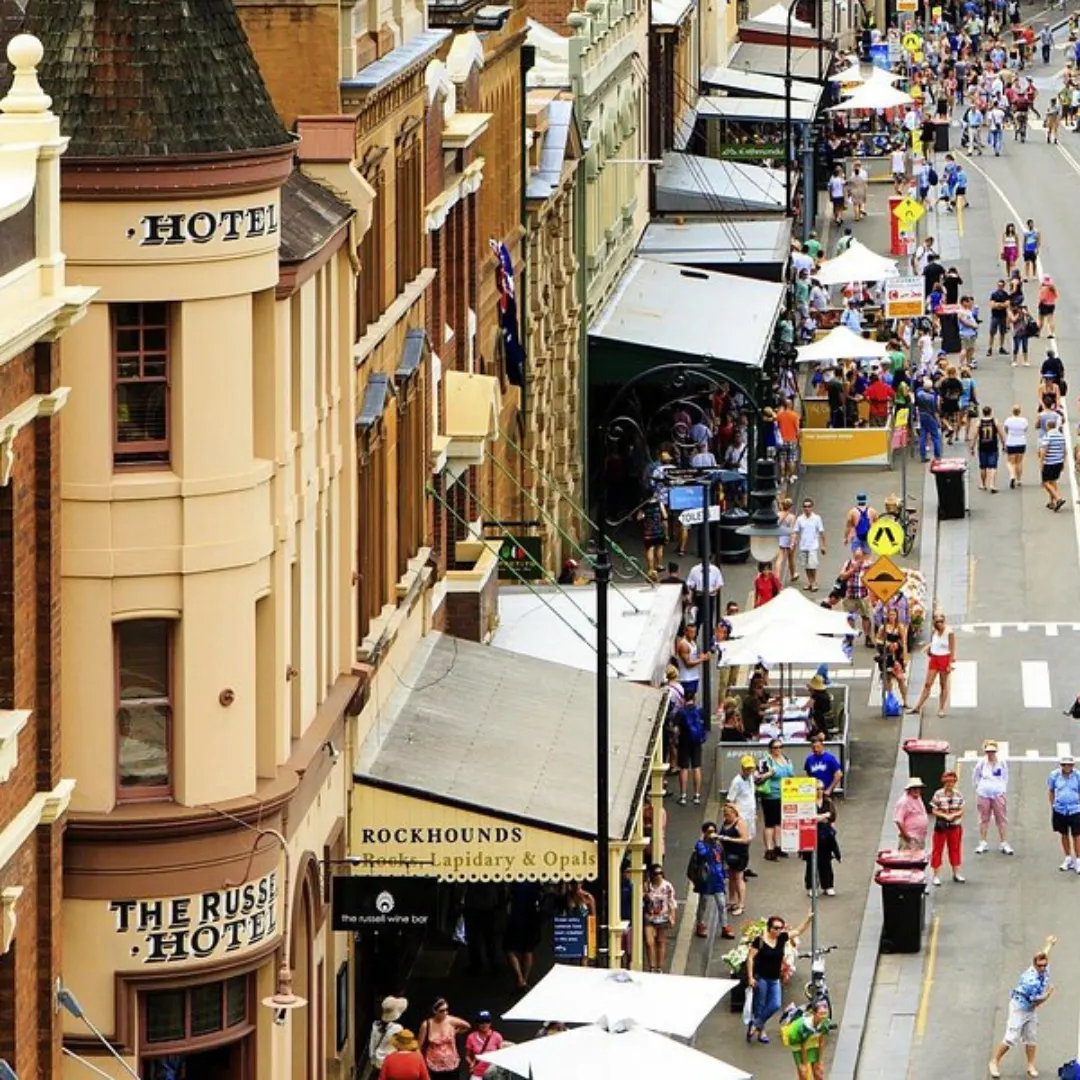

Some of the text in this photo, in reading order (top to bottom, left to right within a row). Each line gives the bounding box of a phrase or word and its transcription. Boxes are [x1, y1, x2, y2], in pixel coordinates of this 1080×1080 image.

[140, 205, 278, 247] HOTEL
[362, 827, 523, 844] ROCKHOUNDS
[430, 851, 517, 872] Lapidary
[523, 851, 536, 866] &
[543, 850, 598, 871] Opals
[108, 899, 192, 933] THE
[387, 914, 409, 924] wine
[411, 914, 428, 924] bar
[144, 904, 277, 963] HOTEL
